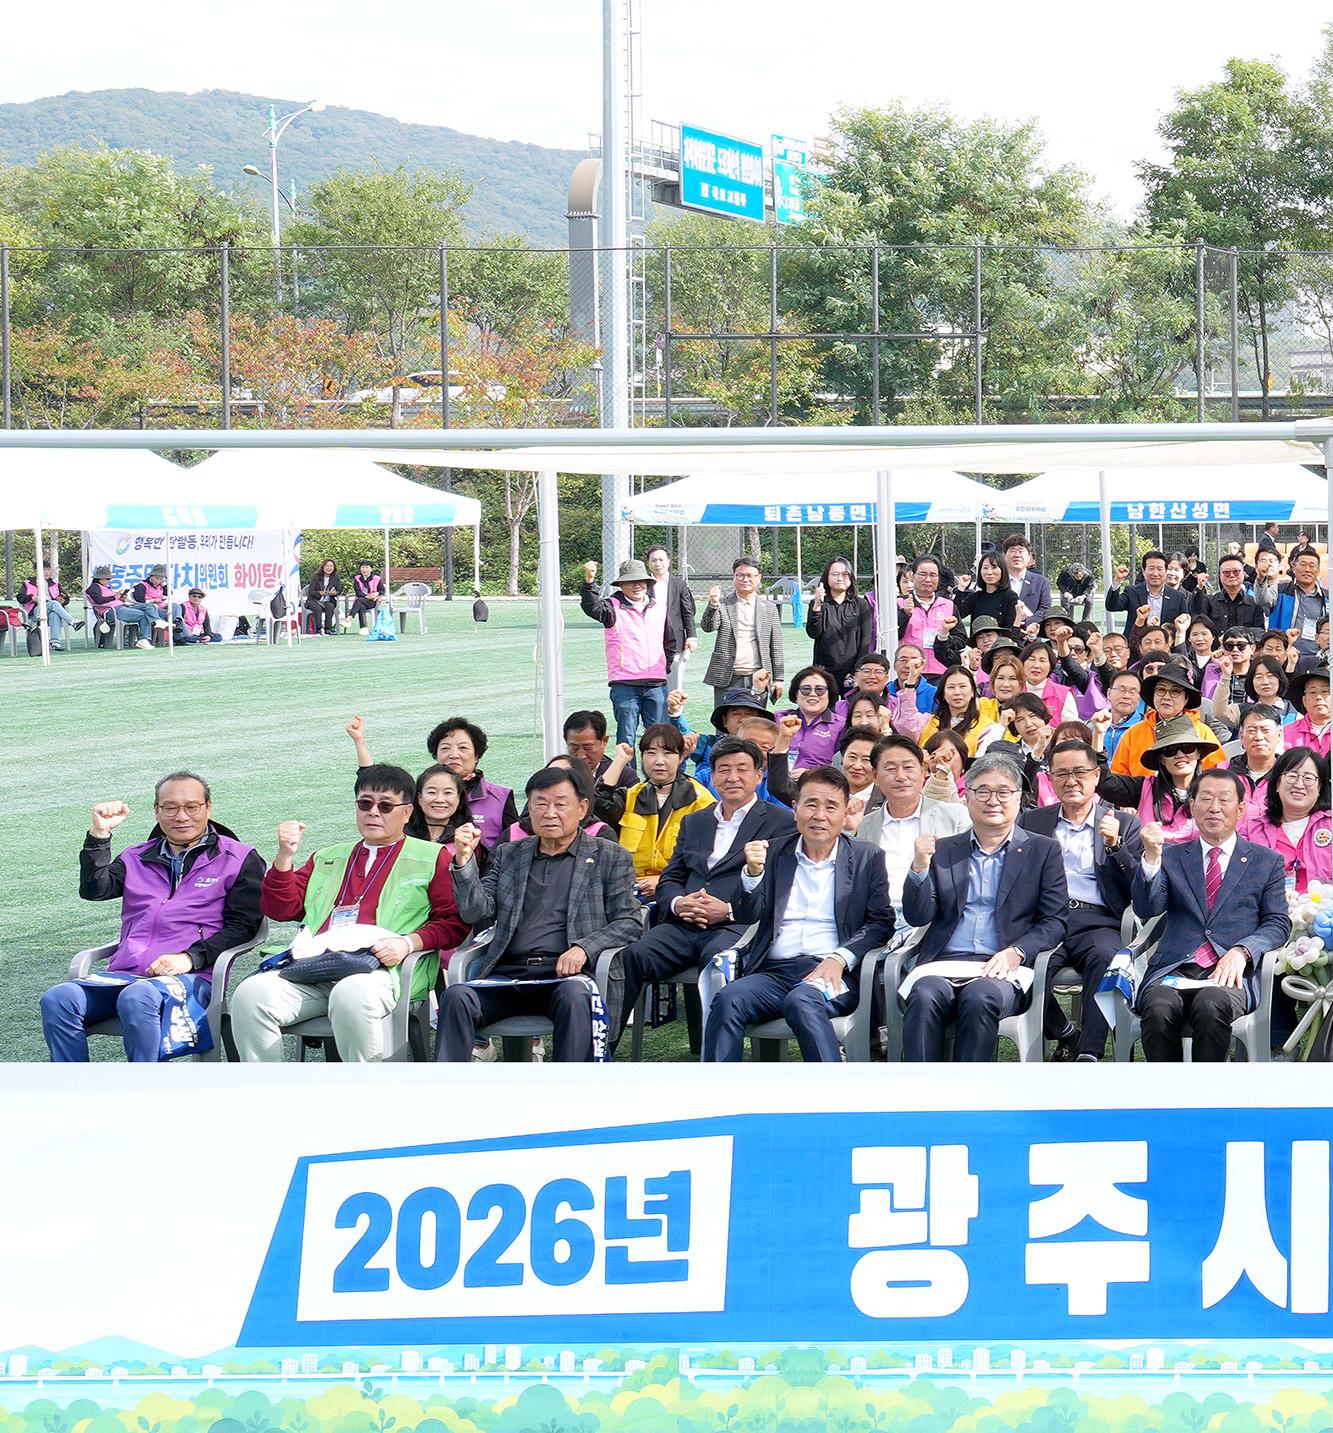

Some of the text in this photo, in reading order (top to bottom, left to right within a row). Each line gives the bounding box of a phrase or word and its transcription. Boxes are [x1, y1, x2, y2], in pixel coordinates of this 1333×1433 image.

[764, 505, 867, 522] 퇴촌남종면
[1126, 502, 1230, 519] 남한산성면
[134, 535, 165, 550] 행복한
[219, 535, 255, 550] 만듭니다!
[234, 561, 284, 589] 화이팅!
[332, 1169, 692, 1293] 2026년
[848, 1140, 1330, 1318] 광주시
